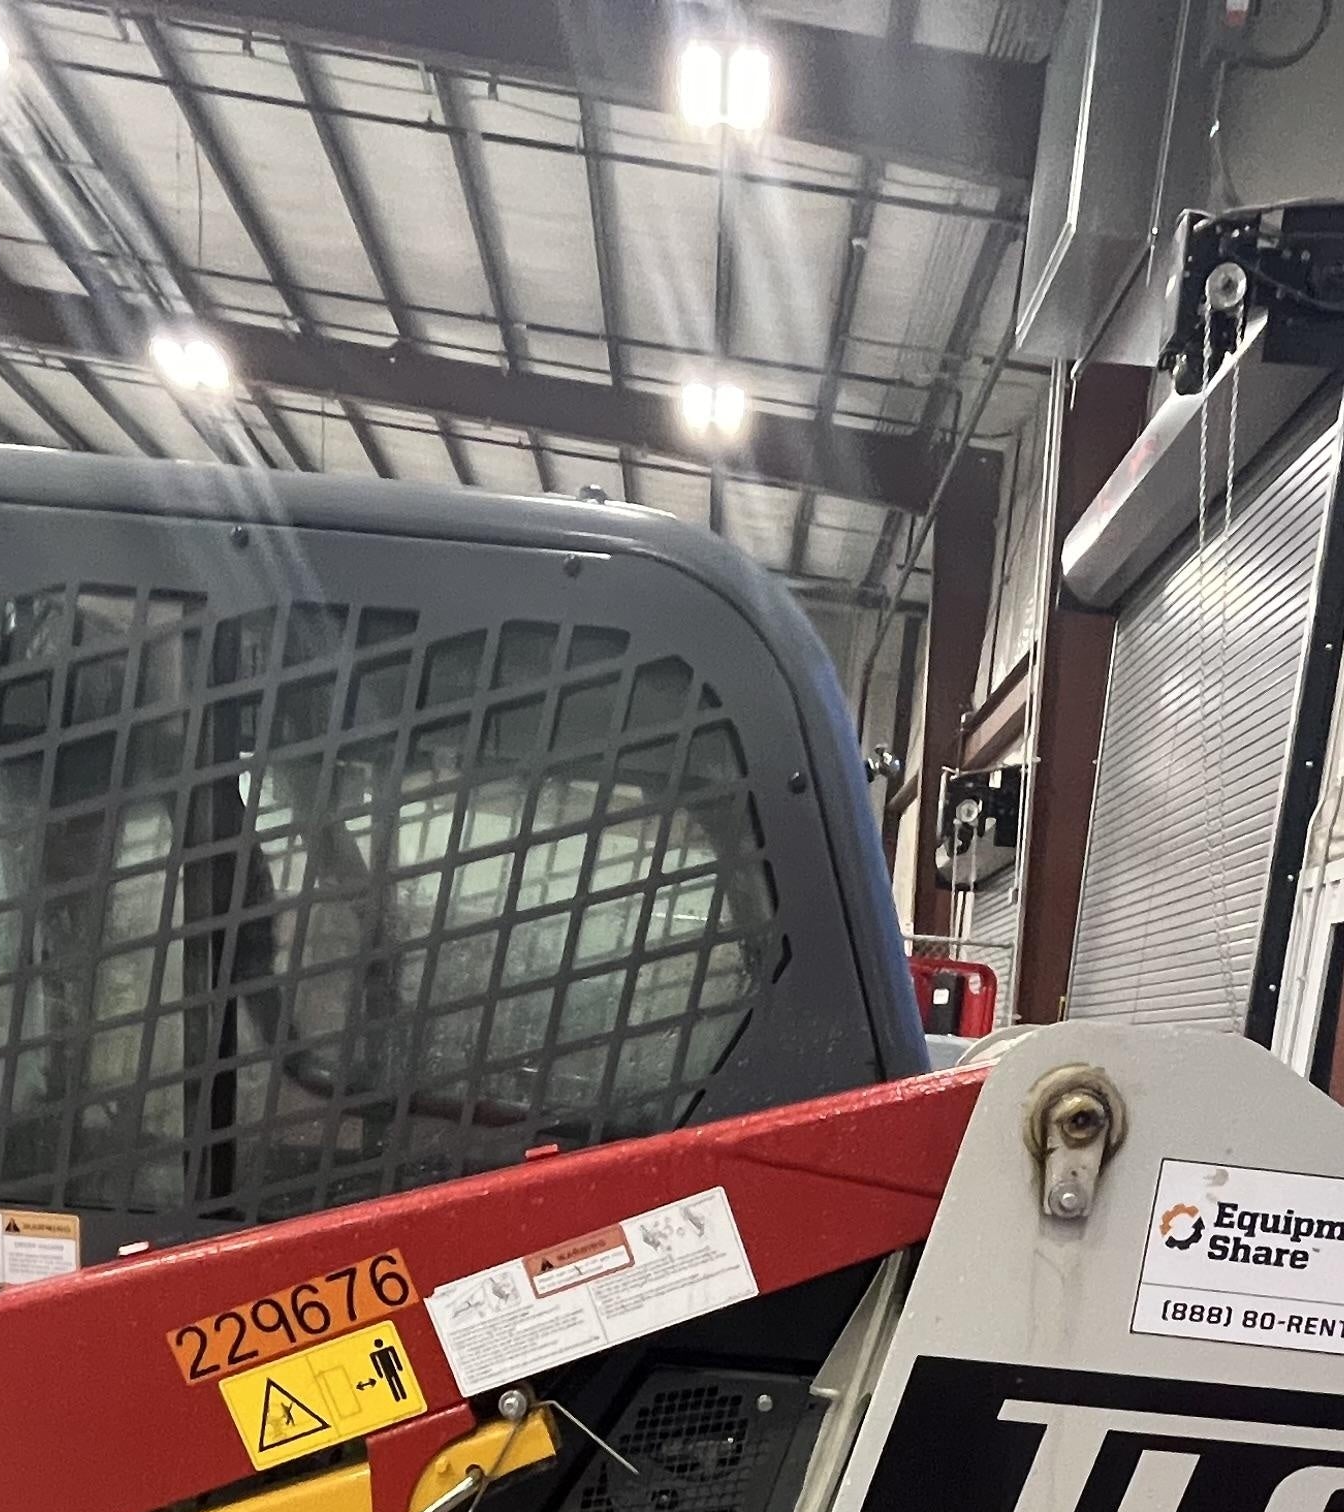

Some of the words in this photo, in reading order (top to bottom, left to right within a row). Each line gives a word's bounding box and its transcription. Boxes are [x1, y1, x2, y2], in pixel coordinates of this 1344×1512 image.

[1207, 1234, 1310, 1270] Share
[174, 1254, 410, 1381] 229676
[1161, 1299, 1234, 1328] (888)
